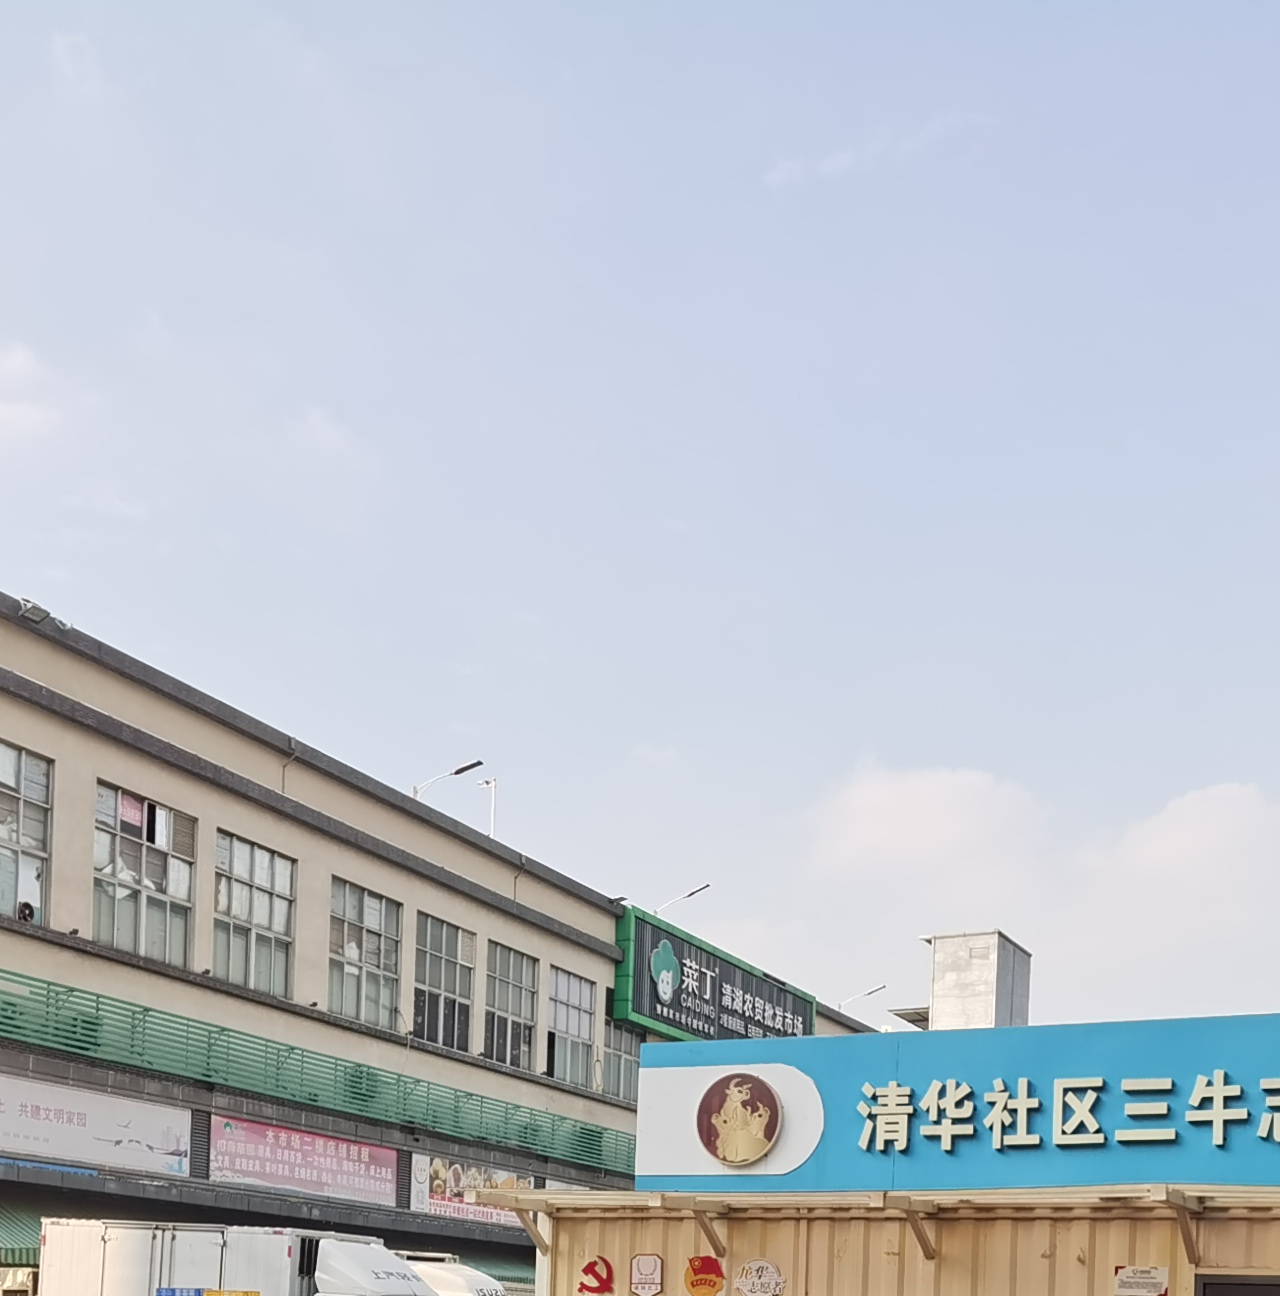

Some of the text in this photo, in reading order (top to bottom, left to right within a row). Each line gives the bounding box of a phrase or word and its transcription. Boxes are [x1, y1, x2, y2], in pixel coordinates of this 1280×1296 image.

[681, 958, 716, 1000] 菜丁
[681, 995, 716, 1019] CAIDING
[721, 982, 803, 1038] 清湖农贸批发市场
[18, 1103, 88, 1128] 共建文明家园
